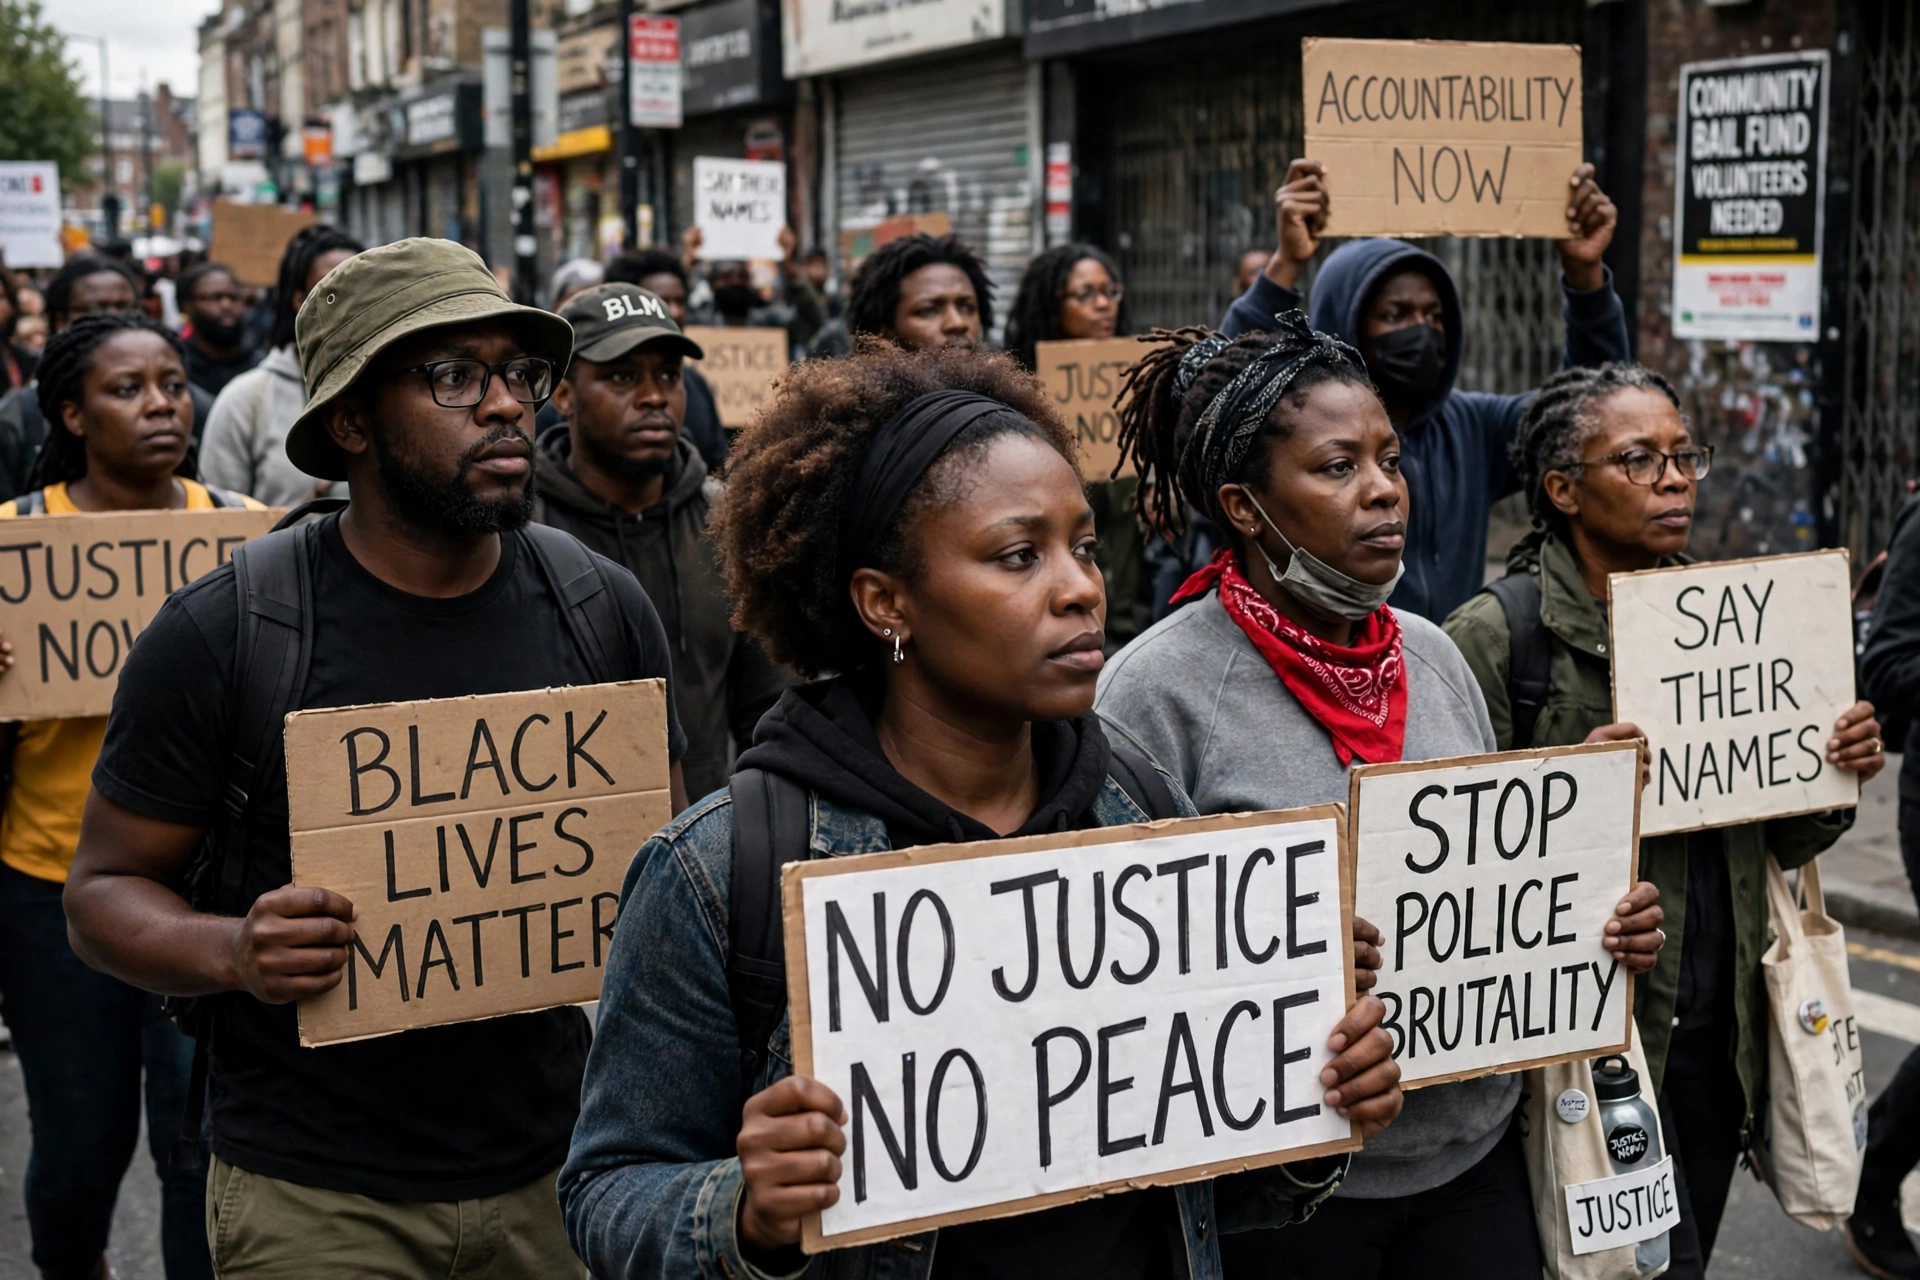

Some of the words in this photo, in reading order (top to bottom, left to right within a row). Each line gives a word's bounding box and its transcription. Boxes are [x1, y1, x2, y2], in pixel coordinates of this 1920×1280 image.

[1316, 71, 1574, 127] ACCOUNTABILITY
[1689, 68, 1818, 117] COMMUNITY
[1691, 118, 1742, 160] BAIL
[1745, 111, 1811, 157] FUND
[1394, 145, 1511, 205] NOW
[1691, 160, 1808, 199] VOLUNTEERS
[1710, 199, 1784, 235] NEEDED
[602, 294, 666, 321] BLM
[1054, 361, 1130, 403] JUST
[1076, 411, 1121, 444] NO
[1674, 579, 1774, 650] SAY
[38, 619, 132, 683] NO
[1660, 658, 1800, 725] THEIR
[340, 709, 616, 816] BLACK
[1659, 724, 1822, 806] NAMES
[384, 807, 595, 902] LIVES
[1404, 771, 1578, 874] STOP
[347, 891, 620, 1011] MATTER
[825, 888, 955, 1032] NO
[990, 840, 1328, 1002] JUSTICE
[1394, 872, 1579, 972] POLICE
[1377, 959, 1619, 1060] BRUTALITY
[850, 1048, 988, 1205] NO
[1031, 989, 1321, 1172] PEACE
[1576, 1173, 1673, 1237] JUSTICE
